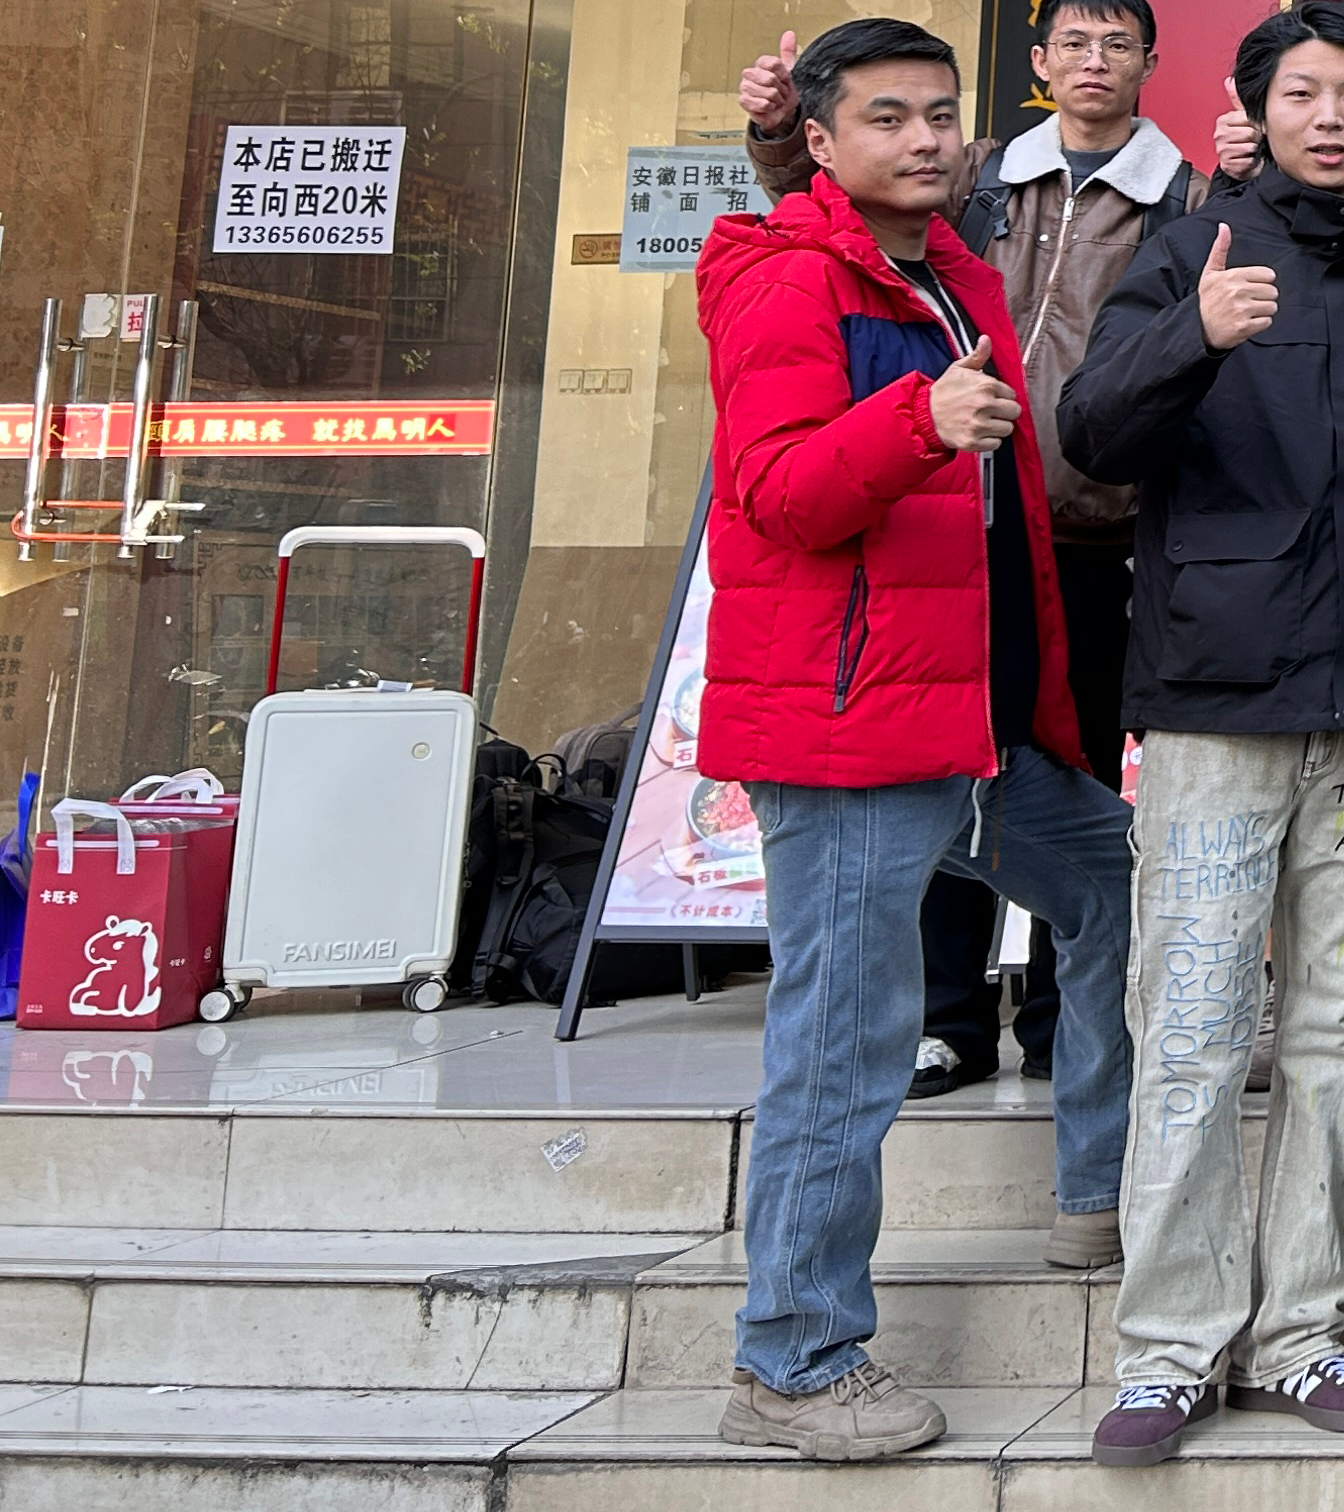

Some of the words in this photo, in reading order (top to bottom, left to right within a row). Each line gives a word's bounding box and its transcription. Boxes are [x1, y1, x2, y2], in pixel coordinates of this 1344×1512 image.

[233, 136, 392, 173] 本店已搬迁
[632, 165, 760, 186] 安徽日报社
[227, 182, 388, 218] 至向西20米
[225, 226, 385, 245] 13365606255
[1165, 811, 1266, 861] ALWAYS
[40, 890, 79, 905] 卡旺卡
[283, 939, 397, 963] FANSIMEI
[1200, 939, 1235, 1049] MUCH
[1157, 914, 1202, 1144] TOMORROW
